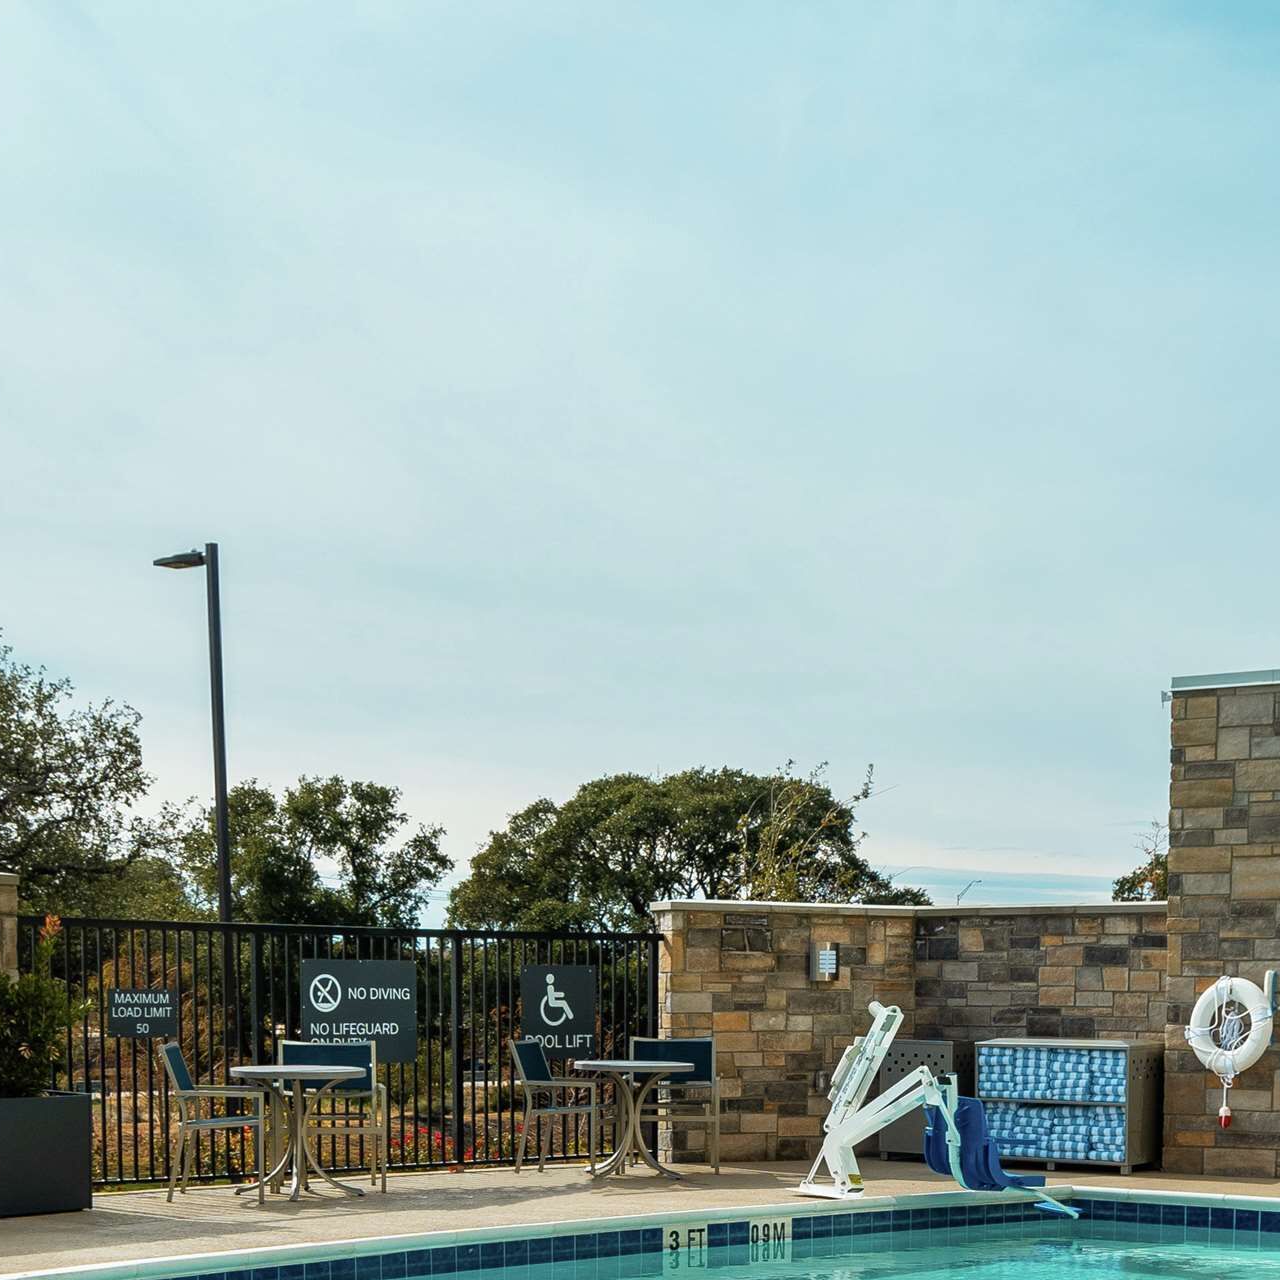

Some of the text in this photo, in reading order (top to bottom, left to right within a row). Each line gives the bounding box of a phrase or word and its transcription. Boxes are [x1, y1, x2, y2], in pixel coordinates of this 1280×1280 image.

[114, 993, 169, 1004] MAXIMUM
[348, 987, 411, 1000] NO DIVING
[112, 1006, 173, 1018] LOAD LIMIT
[136, 1023, 150, 1034] 50
[310, 1022, 399, 1035] NO LIFEGUARD
[565, 1034, 593, 1048] LIFT
[669, 1228, 706, 1251] 3 FT
